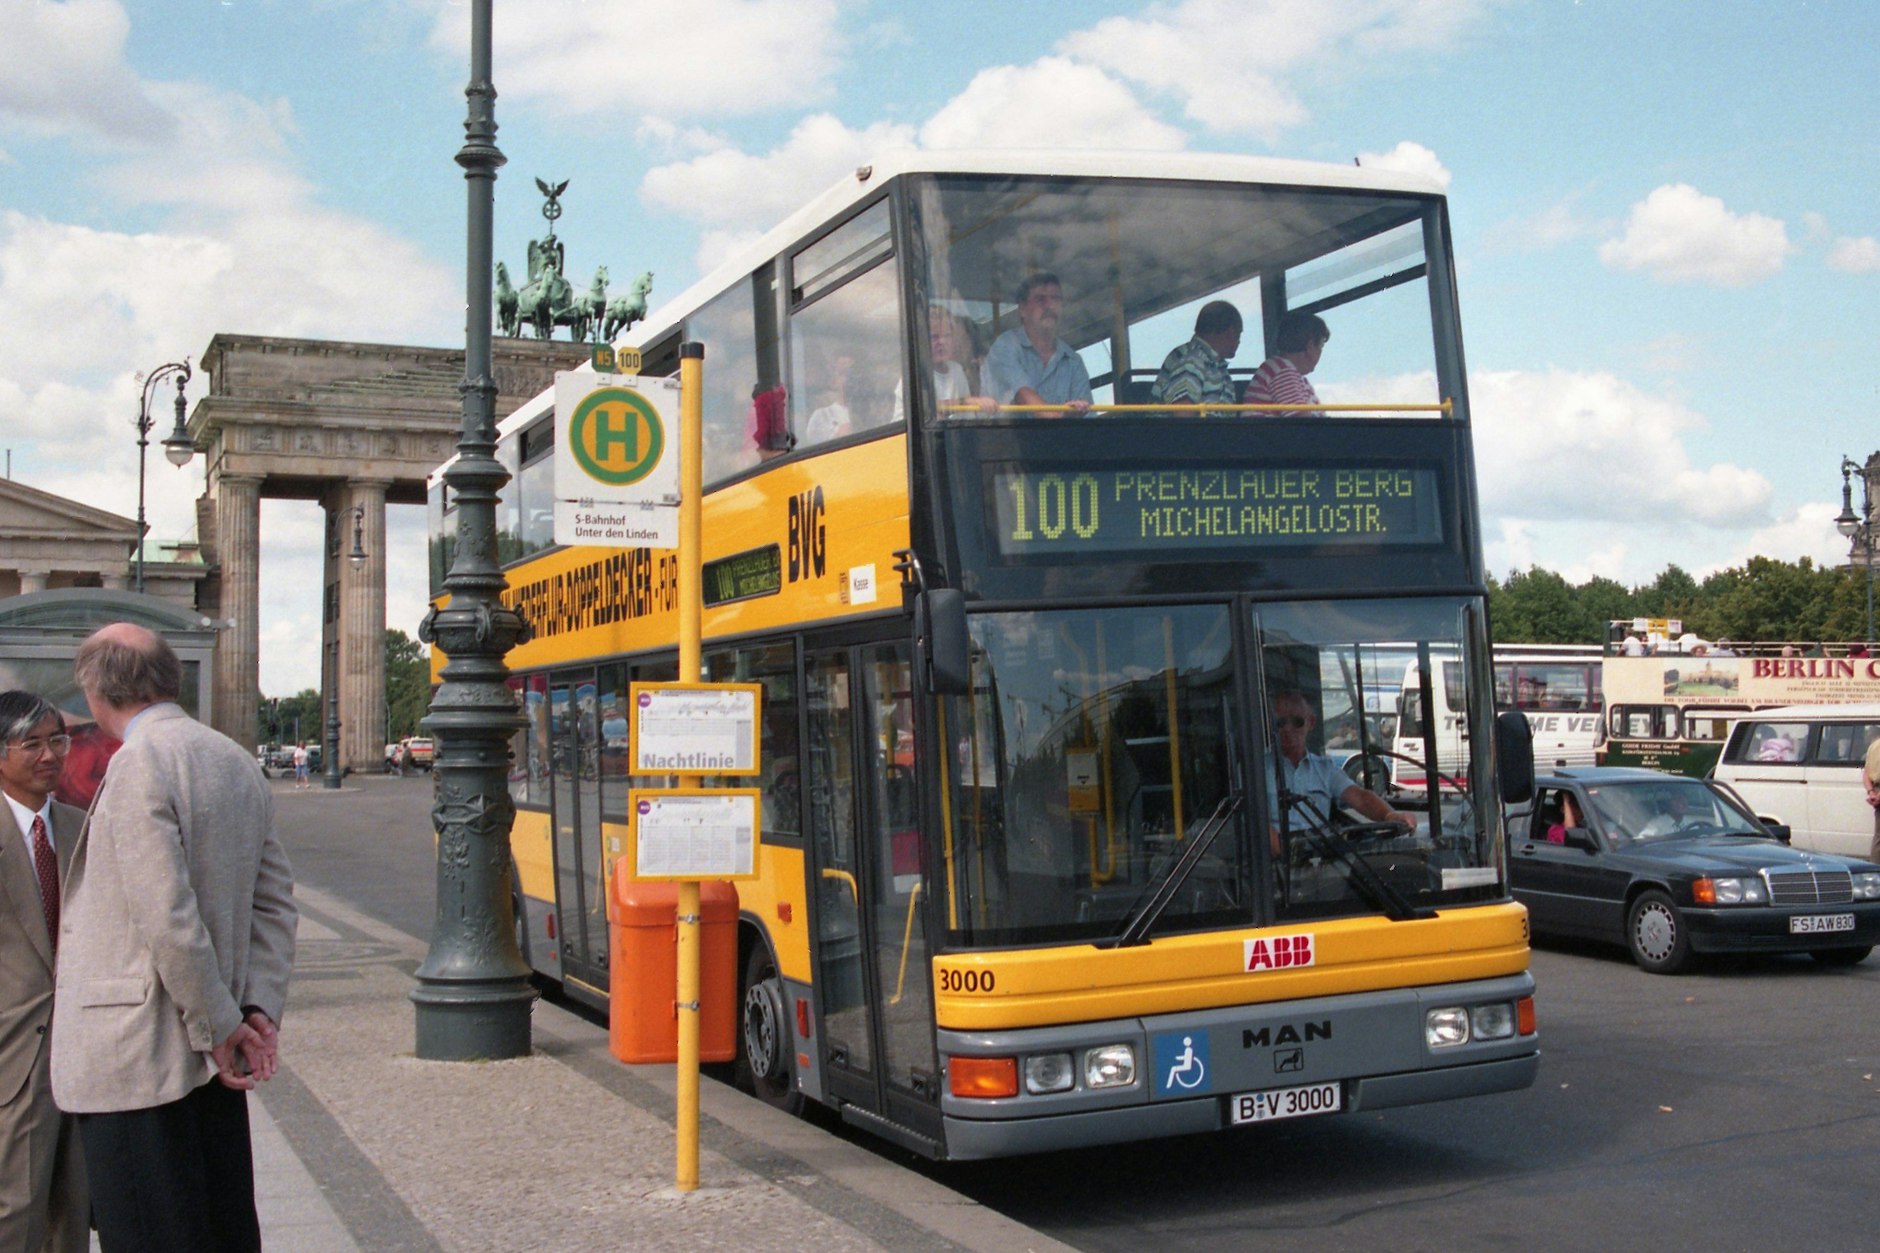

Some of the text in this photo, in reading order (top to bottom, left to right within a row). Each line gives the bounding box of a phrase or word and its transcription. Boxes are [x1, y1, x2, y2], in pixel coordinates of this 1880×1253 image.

[619, 352, 640, 368] 100
[595, 410, 638, 464] H
[1009, 468, 1413, 540] 100 PRENZLAUER BERG
[575, 513, 626, 526] S-Bahnhof
[575, 526, 659, 540] Unter den Linden
[1140, 503, 1388, 538] MICHELANGELOSTR.
[788, 484, 826, 584] BVG
[1753, 658, 1856, 680] BERLIN
[643, 752, 734, 768] Nachtlinie
[1248, 935, 1312, 971] ABB
[939, 968, 996, 993] 3000
[1242, 1020, 1332, 1049] MAN
[1286, 1086, 1334, 1114] 3000
